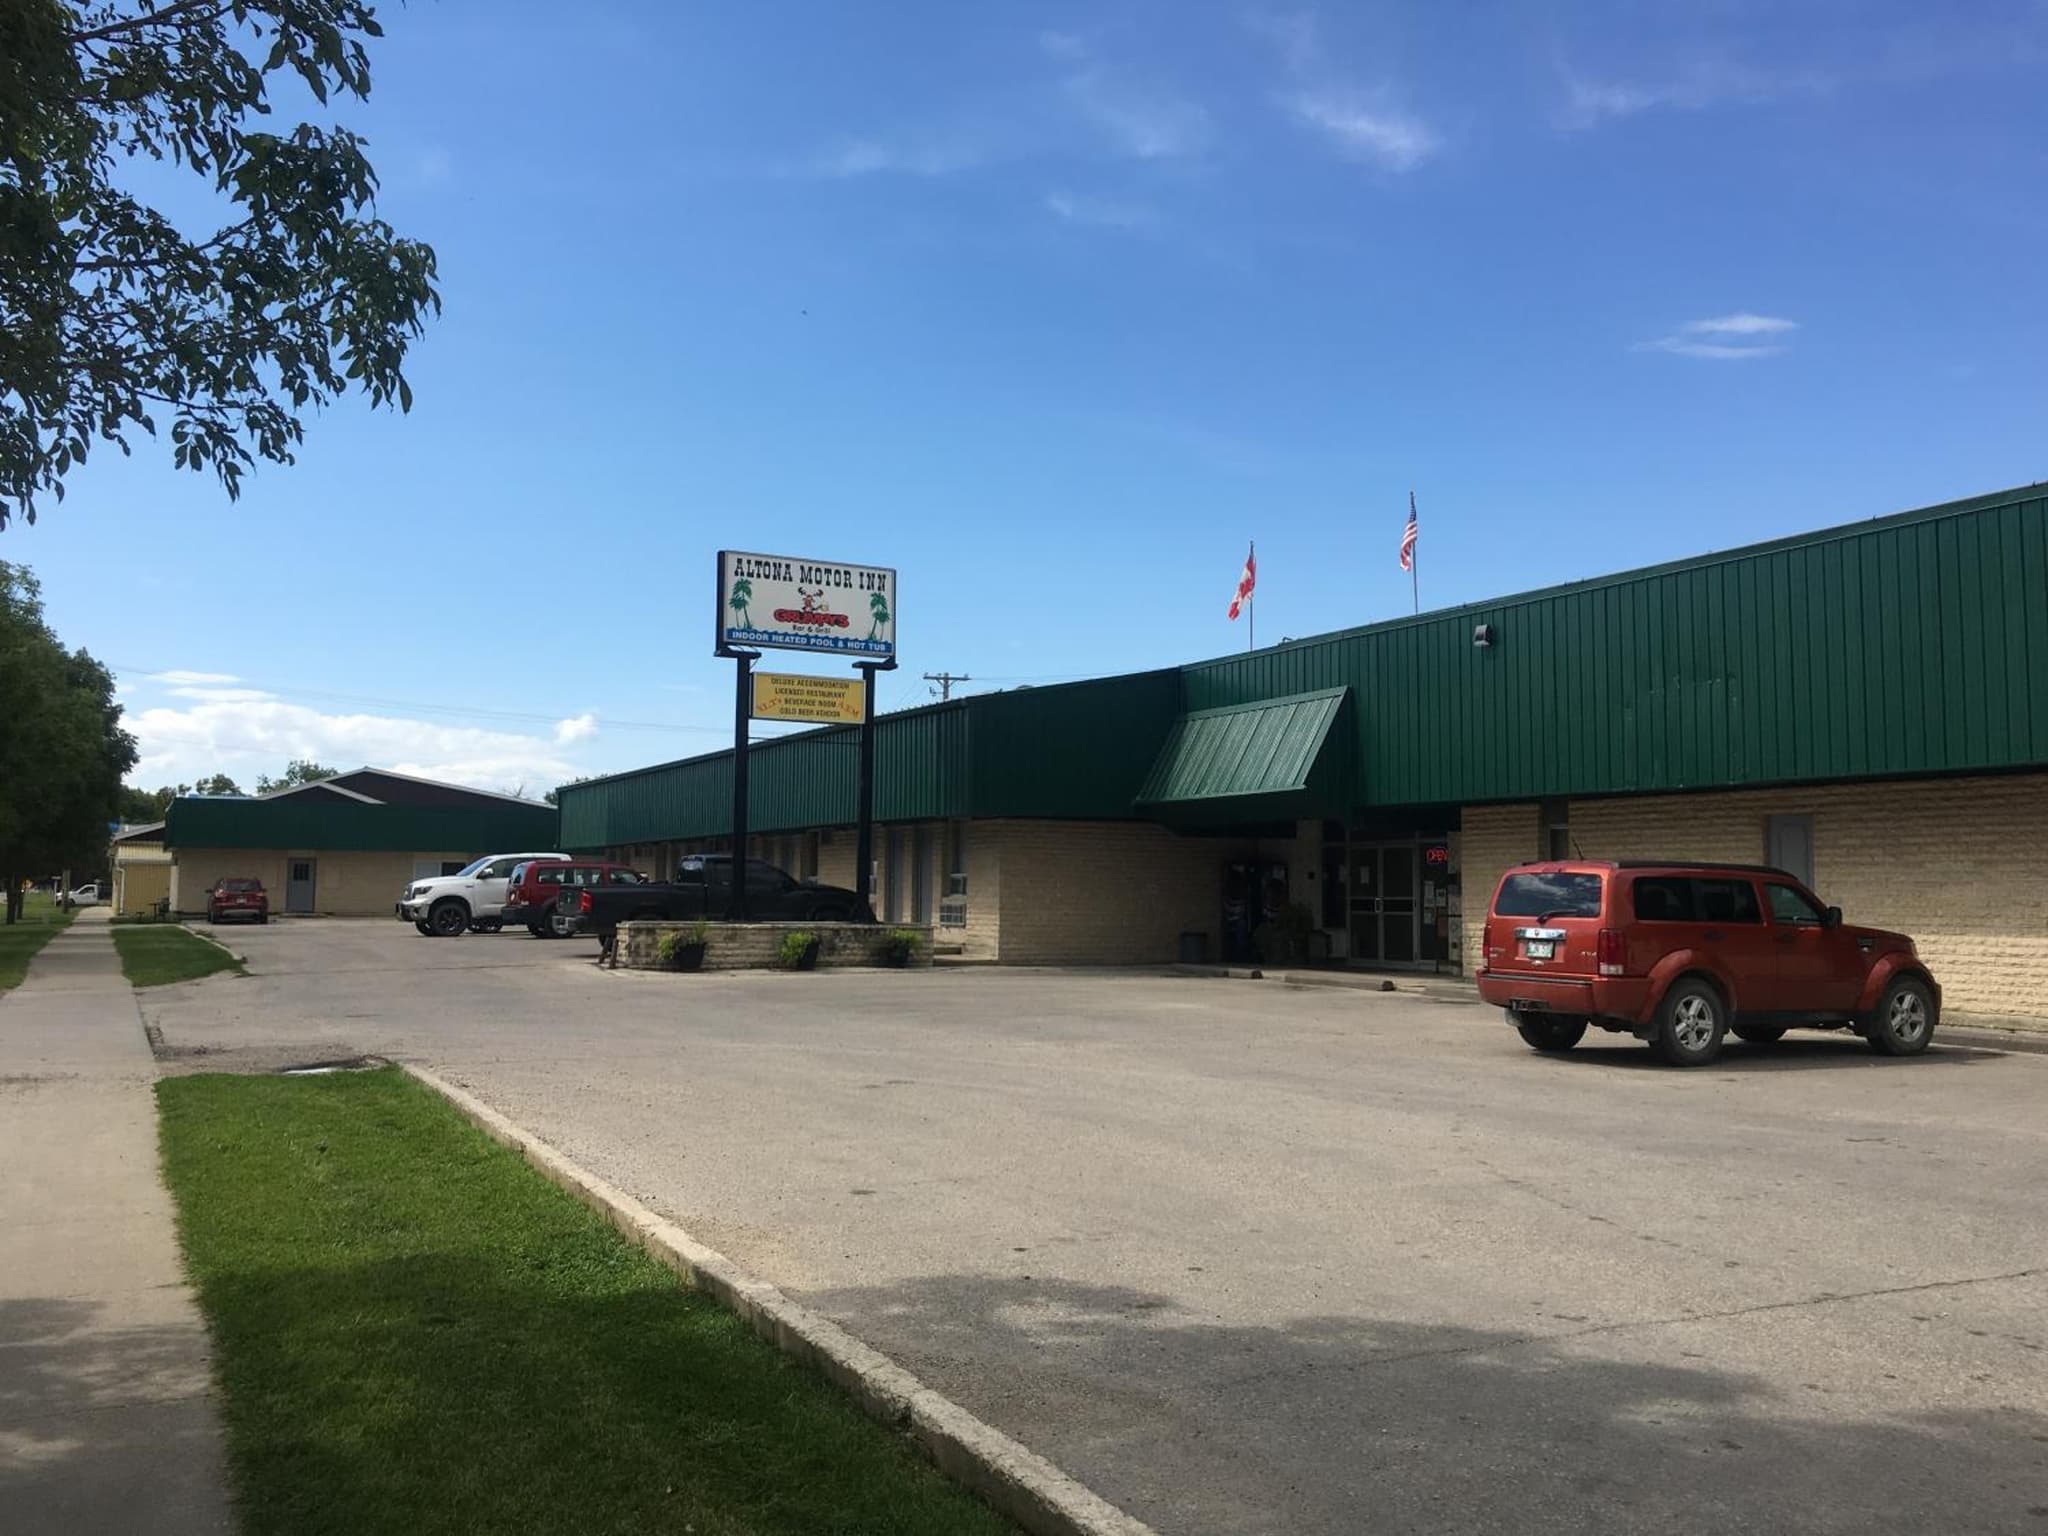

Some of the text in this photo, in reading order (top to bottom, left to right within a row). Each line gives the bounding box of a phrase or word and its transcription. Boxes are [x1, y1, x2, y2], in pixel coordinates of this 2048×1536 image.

[734, 558, 886, 592] ALTONA MOTOR INN
[732, 631, 769, 642] INDOOR
[772, 635, 807, 644] HEATED
[810, 638, 834, 647] POOL
[847, 641, 866, 650] HOT
[868, 643, 886, 651] TUB
[775, 687, 804, 696] LICENSED
[784, 697, 836, 708] BEVERAGE ROOM
[780, 707, 840, 717] COLD BEER VENDOR
[1427, 850, 1448, 861] OPEN
